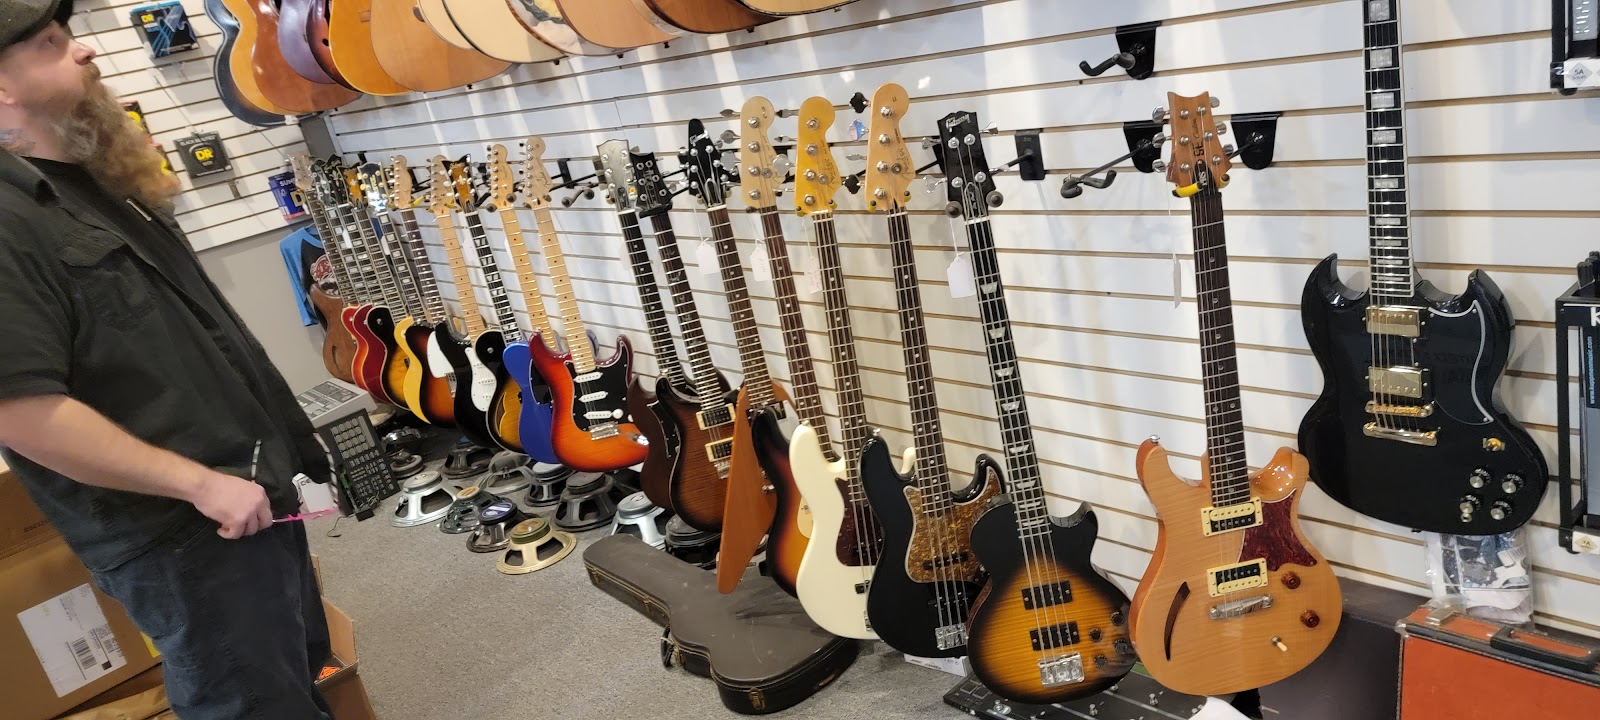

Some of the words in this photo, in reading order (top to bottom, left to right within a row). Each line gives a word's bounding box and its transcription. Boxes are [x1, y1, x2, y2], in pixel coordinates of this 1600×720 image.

[945, 113, 971, 133] Gibson
[195, 148, 213, 161] DR
[1192, 141, 1204, 157] SE
